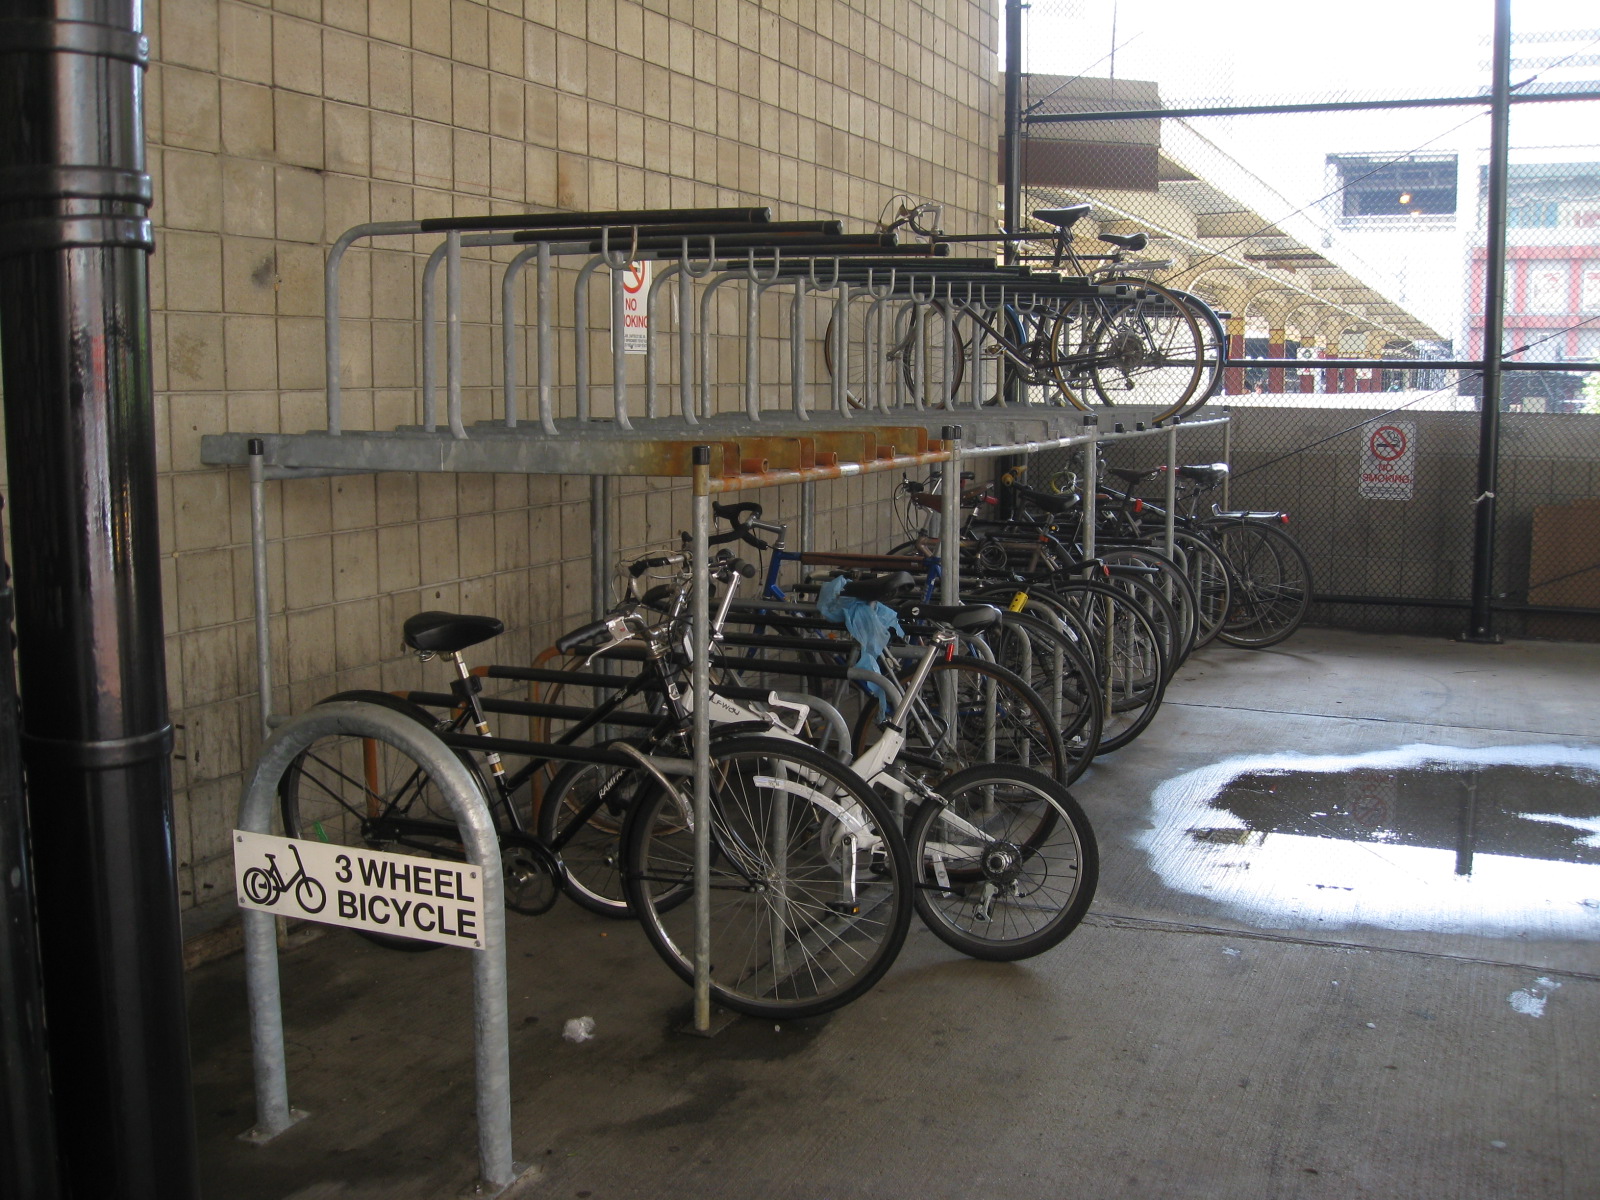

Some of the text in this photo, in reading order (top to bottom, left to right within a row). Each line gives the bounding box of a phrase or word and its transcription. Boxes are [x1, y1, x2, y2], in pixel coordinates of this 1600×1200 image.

[625, 298, 637, 311] NO
[1377, 463, 1393, 472] NO
[1362, 473, 1410, 484] SMOKING
[335, 854, 475, 902] 3 WHEEL
[338, 890, 477, 939] BICYCLE
